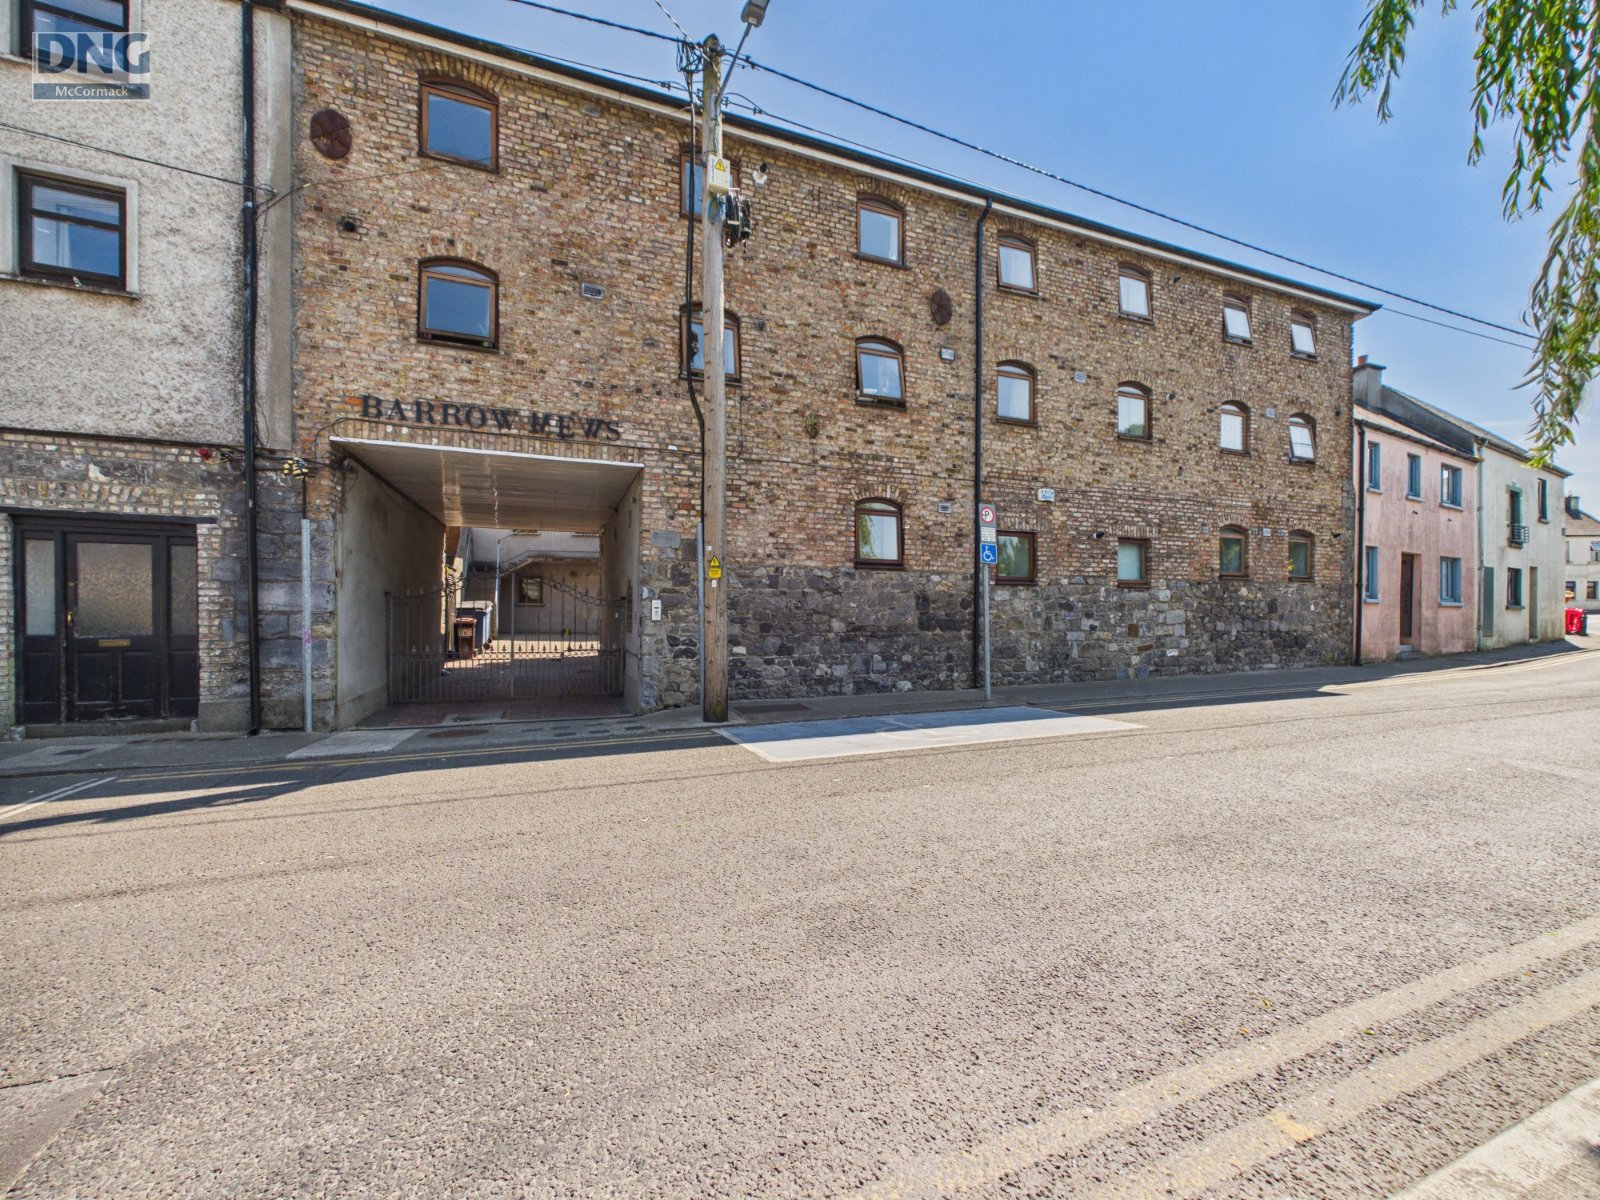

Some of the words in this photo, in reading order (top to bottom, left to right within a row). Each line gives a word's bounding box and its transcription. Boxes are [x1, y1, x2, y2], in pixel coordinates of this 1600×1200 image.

[360, 394, 518, 430] BARROW
[530, 410, 620, 441] MEWS
[984, 510, 990, 520] P
